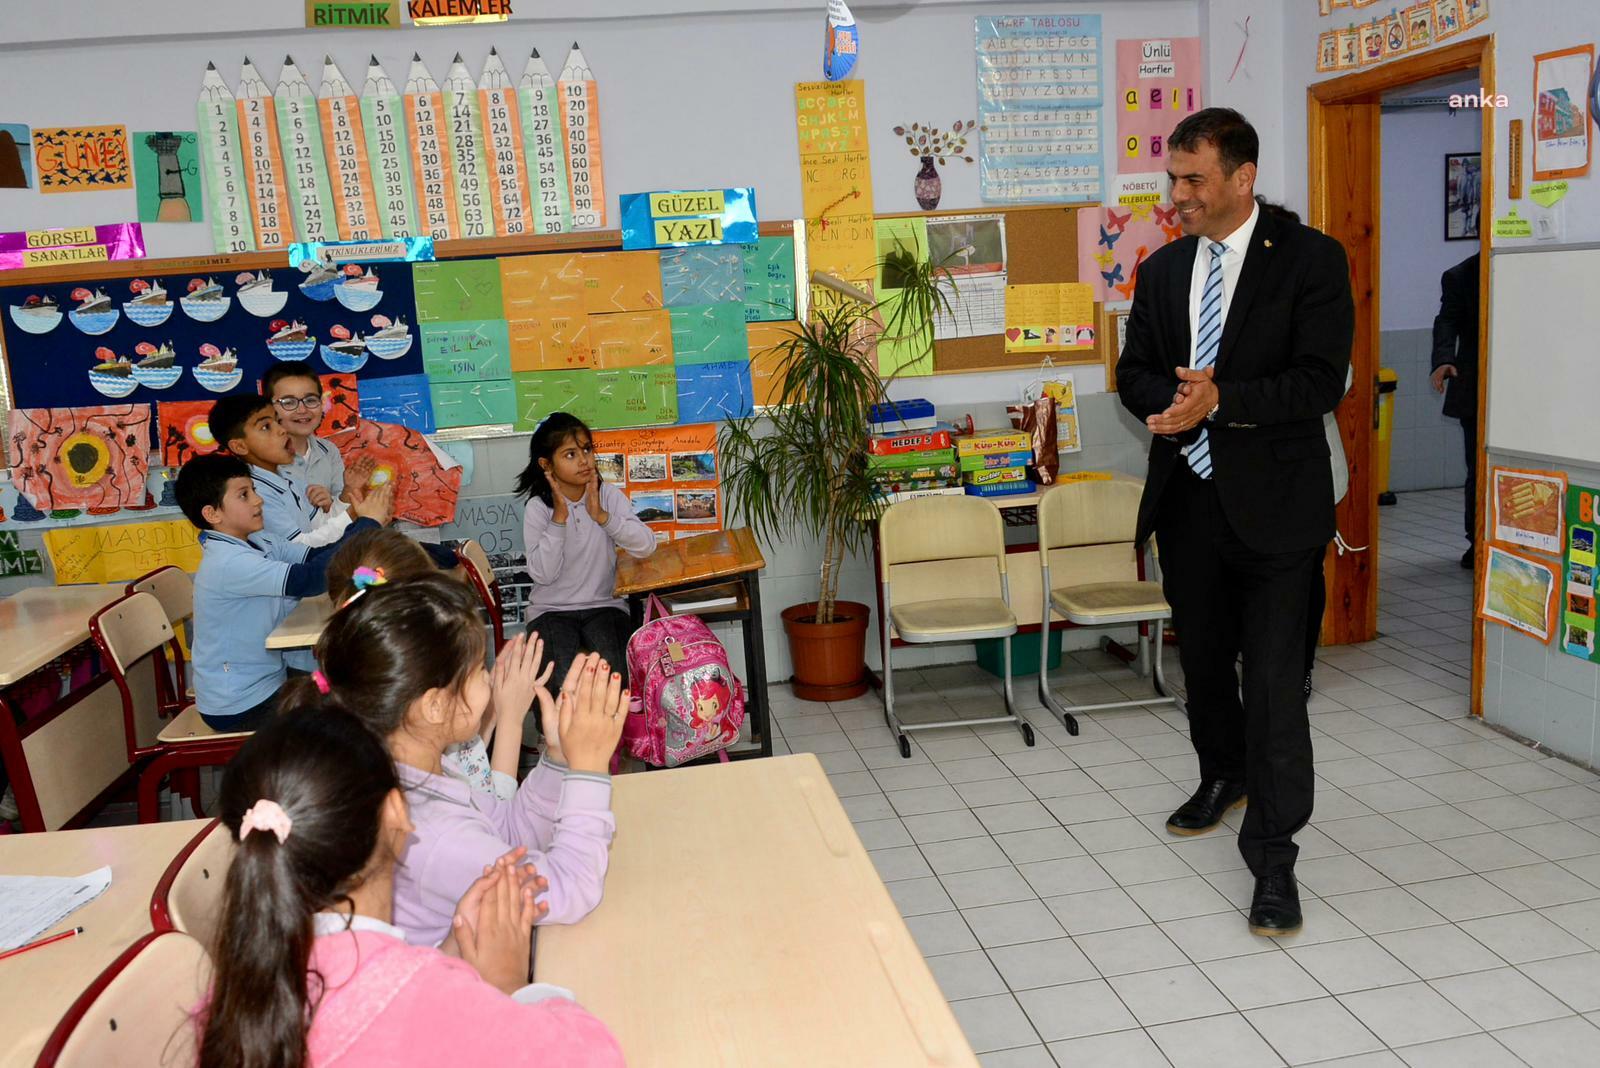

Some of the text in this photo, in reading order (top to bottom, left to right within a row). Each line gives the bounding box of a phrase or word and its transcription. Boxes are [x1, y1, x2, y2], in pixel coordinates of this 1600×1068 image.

[314, 4, 390, 25] RİTMİK
[408, 0, 513, 18] KALEMLER
[1031, 17, 1080, 28] TABLOSU
[1143, 42, 1171, 58] Ünlü
[1139, 64, 1172, 75] Harfler
[536, 90, 543, 101] 9
[567, 86, 582, 96] 10
[419, 96, 426, 107] 6
[456, 92, 464, 105] 7
[492, 93, 500, 104] 8
[1126, 90, 1137, 104] a
[1151, 89, 1162, 103] e
[1188, 88, 1193, 107] i
[216, 105, 223, 115] 1
[252, 101, 258, 112] 2
[290, 102, 298, 113] 3
[333, 101, 341, 112] 4
[377, 100, 384, 111] 5
[533, 105, 548, 116] 18
[570, 100, 585, 110] 20
[416, 110, 432, 122] 12
[453, 105, 471, 118] 14
[491, 108, 506, 119] 16
[252, 117, 260, 127] 4
[294, 118, 302, 129] 6
[338, 116, 346, 126] 8
[376, 114, 391, 126] 10
[534, 120, 548, 130] 27
[570, 115, 584, 126] 30
[219, 121, 227, 132] 2
[419, 124, 434, 136] 18
[454, 120, 472, 132] 21
[492, 122, 507, 134] 24
[220, 135, 227, 146] 3
[254, 132, 262, 143] 6
[296, 133, 304, 144] 9
[335, 130, 350, 141] 12
[379, 130, 393, 142] 15
[536, 134, 552, 145] 36
[570, 130, 584, 141] 40
[421, 140, 436, 151] 24
[456, 135, 473, 148] 28
[496, 136, 511, 148] 32
[1127, 136, 1162, 154] o ö
[255, 146, 262, 157] 8
[295, 147, 311, 158] 12
[339, 144, 354, 156] 16
[380, 142, 395, 154] 20
[538, 147, 553, 158] 45
[572, 144, 586, 154] 50
[222, 151, 230, 162] 4
[422, 154, 437, 165] 30
[457, 149, 475, 162] 35
[498, 151, 513, 162] 40
[255, 160, 270, 171] 10
[297, 162, 312, 174] 15
[340, 159, 356, 170] 20
[382, 158, 398, 169] 25
[540, 162, 554, 173] 54
[572, 158, 586, 168] 60
[224, 166, 231, 177] 5
[424, 169, 439, 180] 36
[459, 162, 476, 176] 42
[499, 164, 514, 175] 48
[258, 173, 272, 184] 12
[342, 172, 358, 184] 24
[385, 171, 400, 182] 30
[574, 172, 588, 182] 70
[226, 181, 234, 192] 6
[300, 177, 315, 189] 18
[460, 178, 478, 191] 49
[501, 179, 516, 190] 56
[540, 178, 555, 188] 63
[1122, 181, 1157, 191] NÖBETÇİ
[259, 188, 274, 199] 14
[344, 186, 360, 197] 28
[387, 185, 402, 196] 35
[426, 184, 441, 194] 42
[574, 184, 589, 195] 80
[228, 196, 235, 207] 7
[304, 194, 319, 206] 21
[463, 193, 480, 206] 56
[504, 193, 519, 204] 64
[542, 191, 557, 202] 72
[1118, 194, 1161, 204] KELEBEKLER
[261, 203, 276, 214] 16
[348, 201, 363, 212] 32
[388, 200, 404, 211] 40
[428, 198, 443, 209] 48
[576, 199, 590, 210] 90
[658, 195, 719, 213] GÜZEL
[230, 211, 237, 222] 8
[305, 209, 320, 220] 24
[464, 209, 482, 222] 63
[506, 207, 521, 219] 72
[544, 206, 560, 216] 81
[261, 216, 276, 228] 18
[349, 214, 365, 226] 36
[390, 215, 406, 226] 45
[430, 213, 445, 224] 54
[574, 215, 595, 226] 100
[231, 226, 238, 236] 9
[307, 222, 321, 233] 27
[466, 223, 484, 236] 70
[508, 222, 522, 233] 80
[546, 222, 561, 233] 90
[663, 219, 717, 241] YAZI
[28, 230, 94, 247] GÖRSEL
[264, 233, 279, 244] 20
[353, 231, 367, 240] 40
[432, 229, 447, 239] 60
[231, 240, 246, 252] 10
[30, 246, 105, 262] SANATLAR
[892, 436, 931, 448] HEDEF 5
